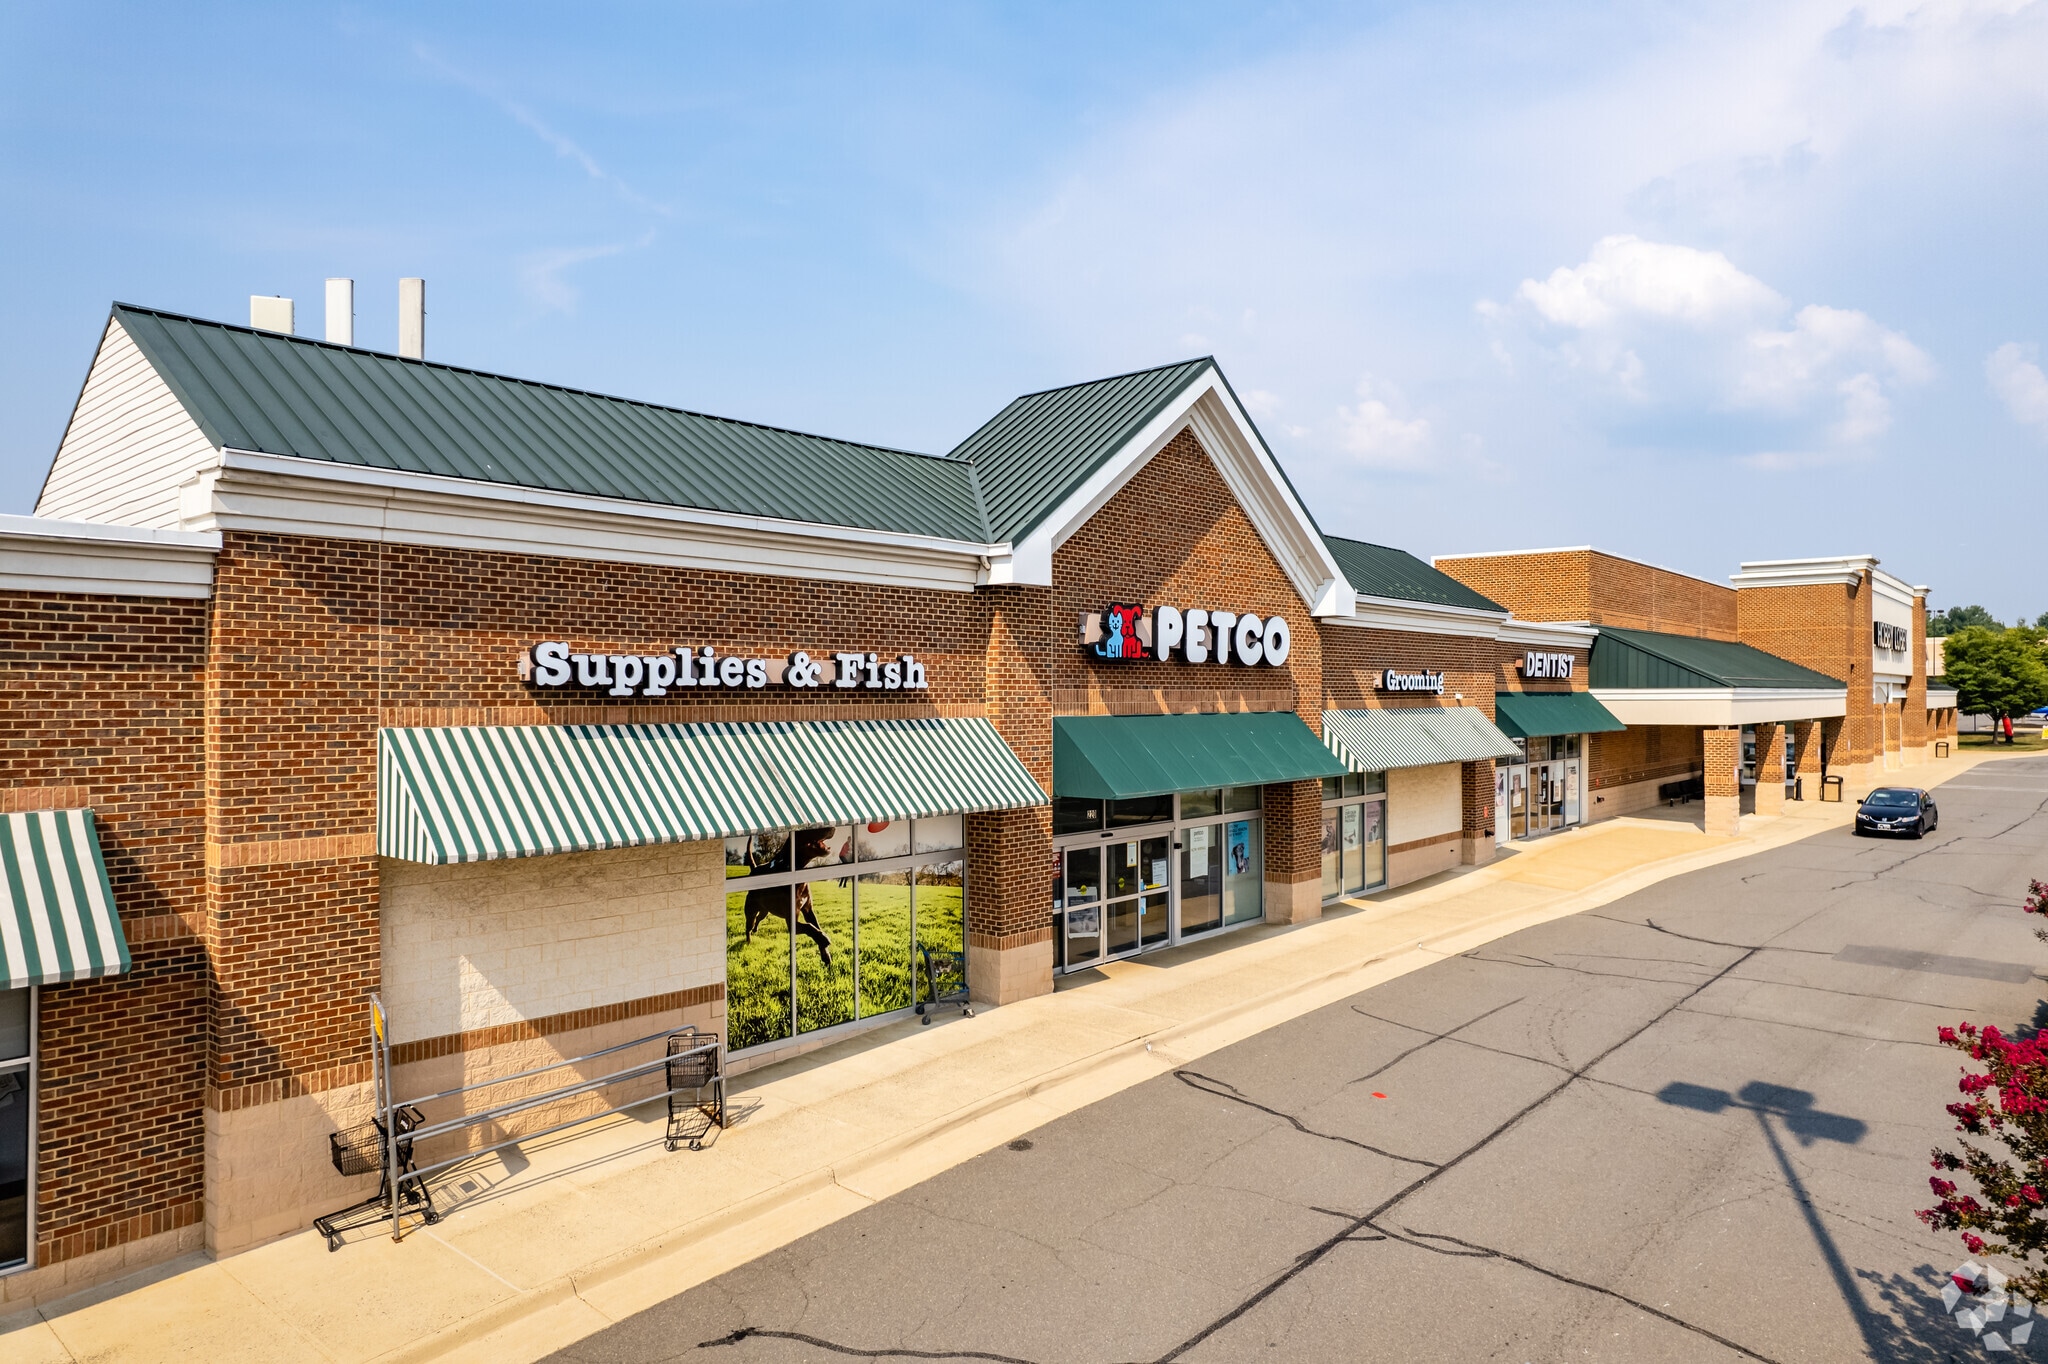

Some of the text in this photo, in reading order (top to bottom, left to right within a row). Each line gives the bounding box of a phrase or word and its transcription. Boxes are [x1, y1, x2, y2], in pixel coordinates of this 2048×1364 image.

[1156, 605, 1291, 667] PETCO
[534, 640, 929, 697] Supplies & Fish
[1385, 668, 1445, 696] Grooming
[1525, 651, 1576, 679] DENTIST
